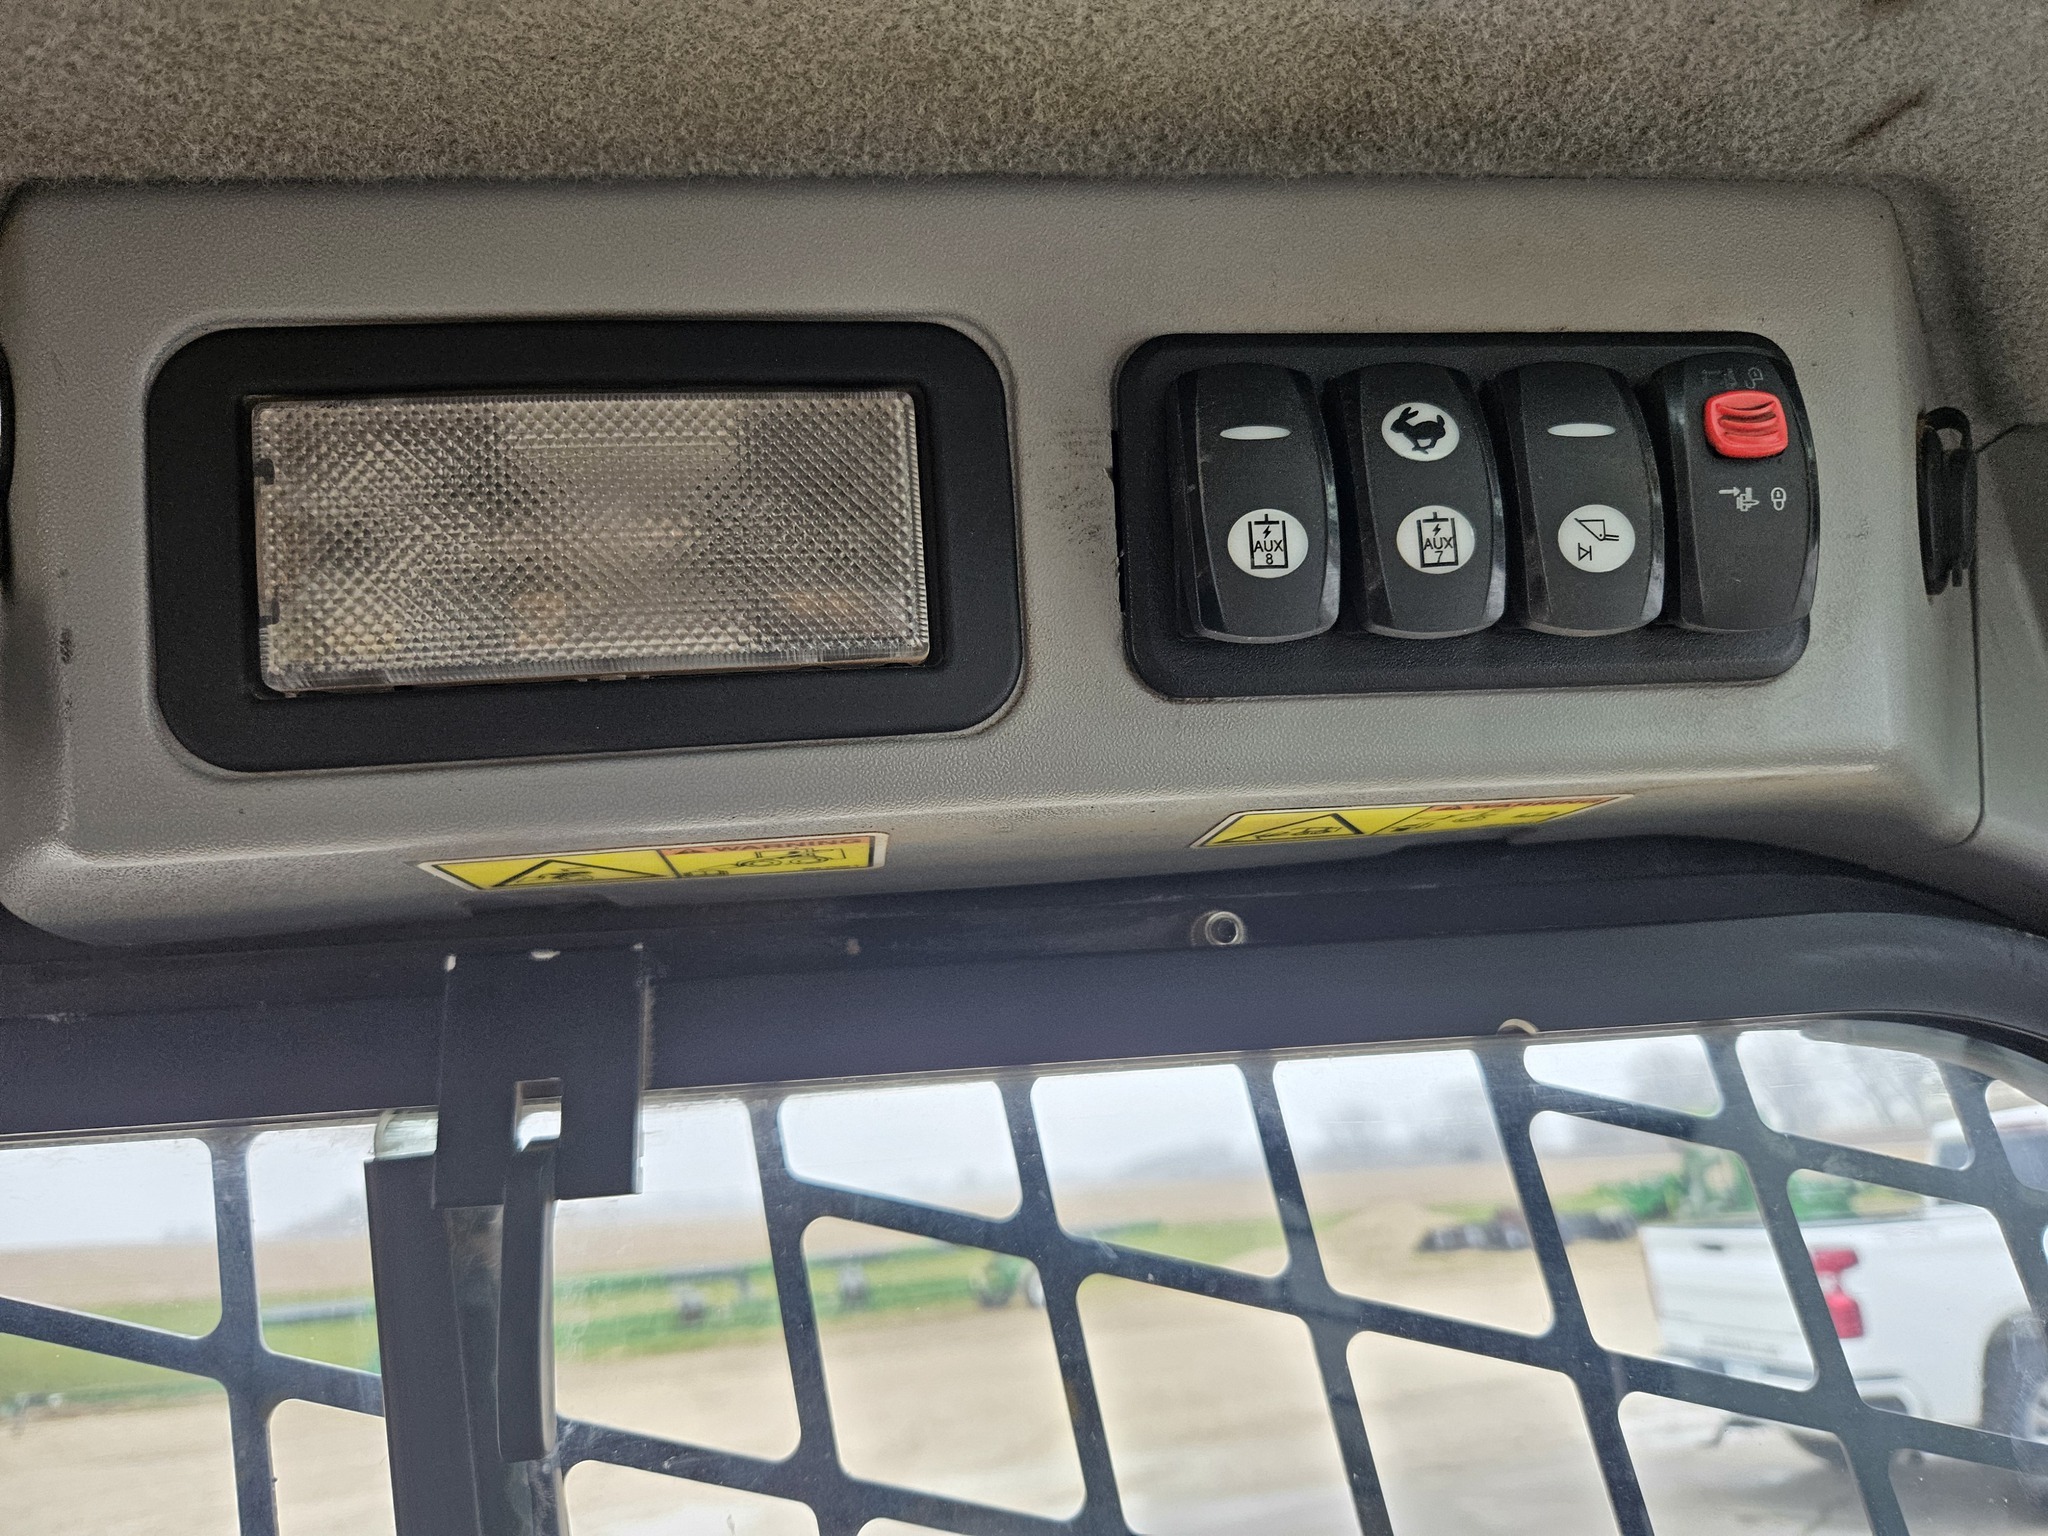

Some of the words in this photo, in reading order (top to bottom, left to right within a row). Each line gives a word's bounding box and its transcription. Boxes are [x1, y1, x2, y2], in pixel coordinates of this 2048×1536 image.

[1253, 540, 1284, 552] AUX
[1423, 536, 1454, 550] AUX
[1265, 553, 1274, 565] 8
[1434, 550, 1443, 564] 7
